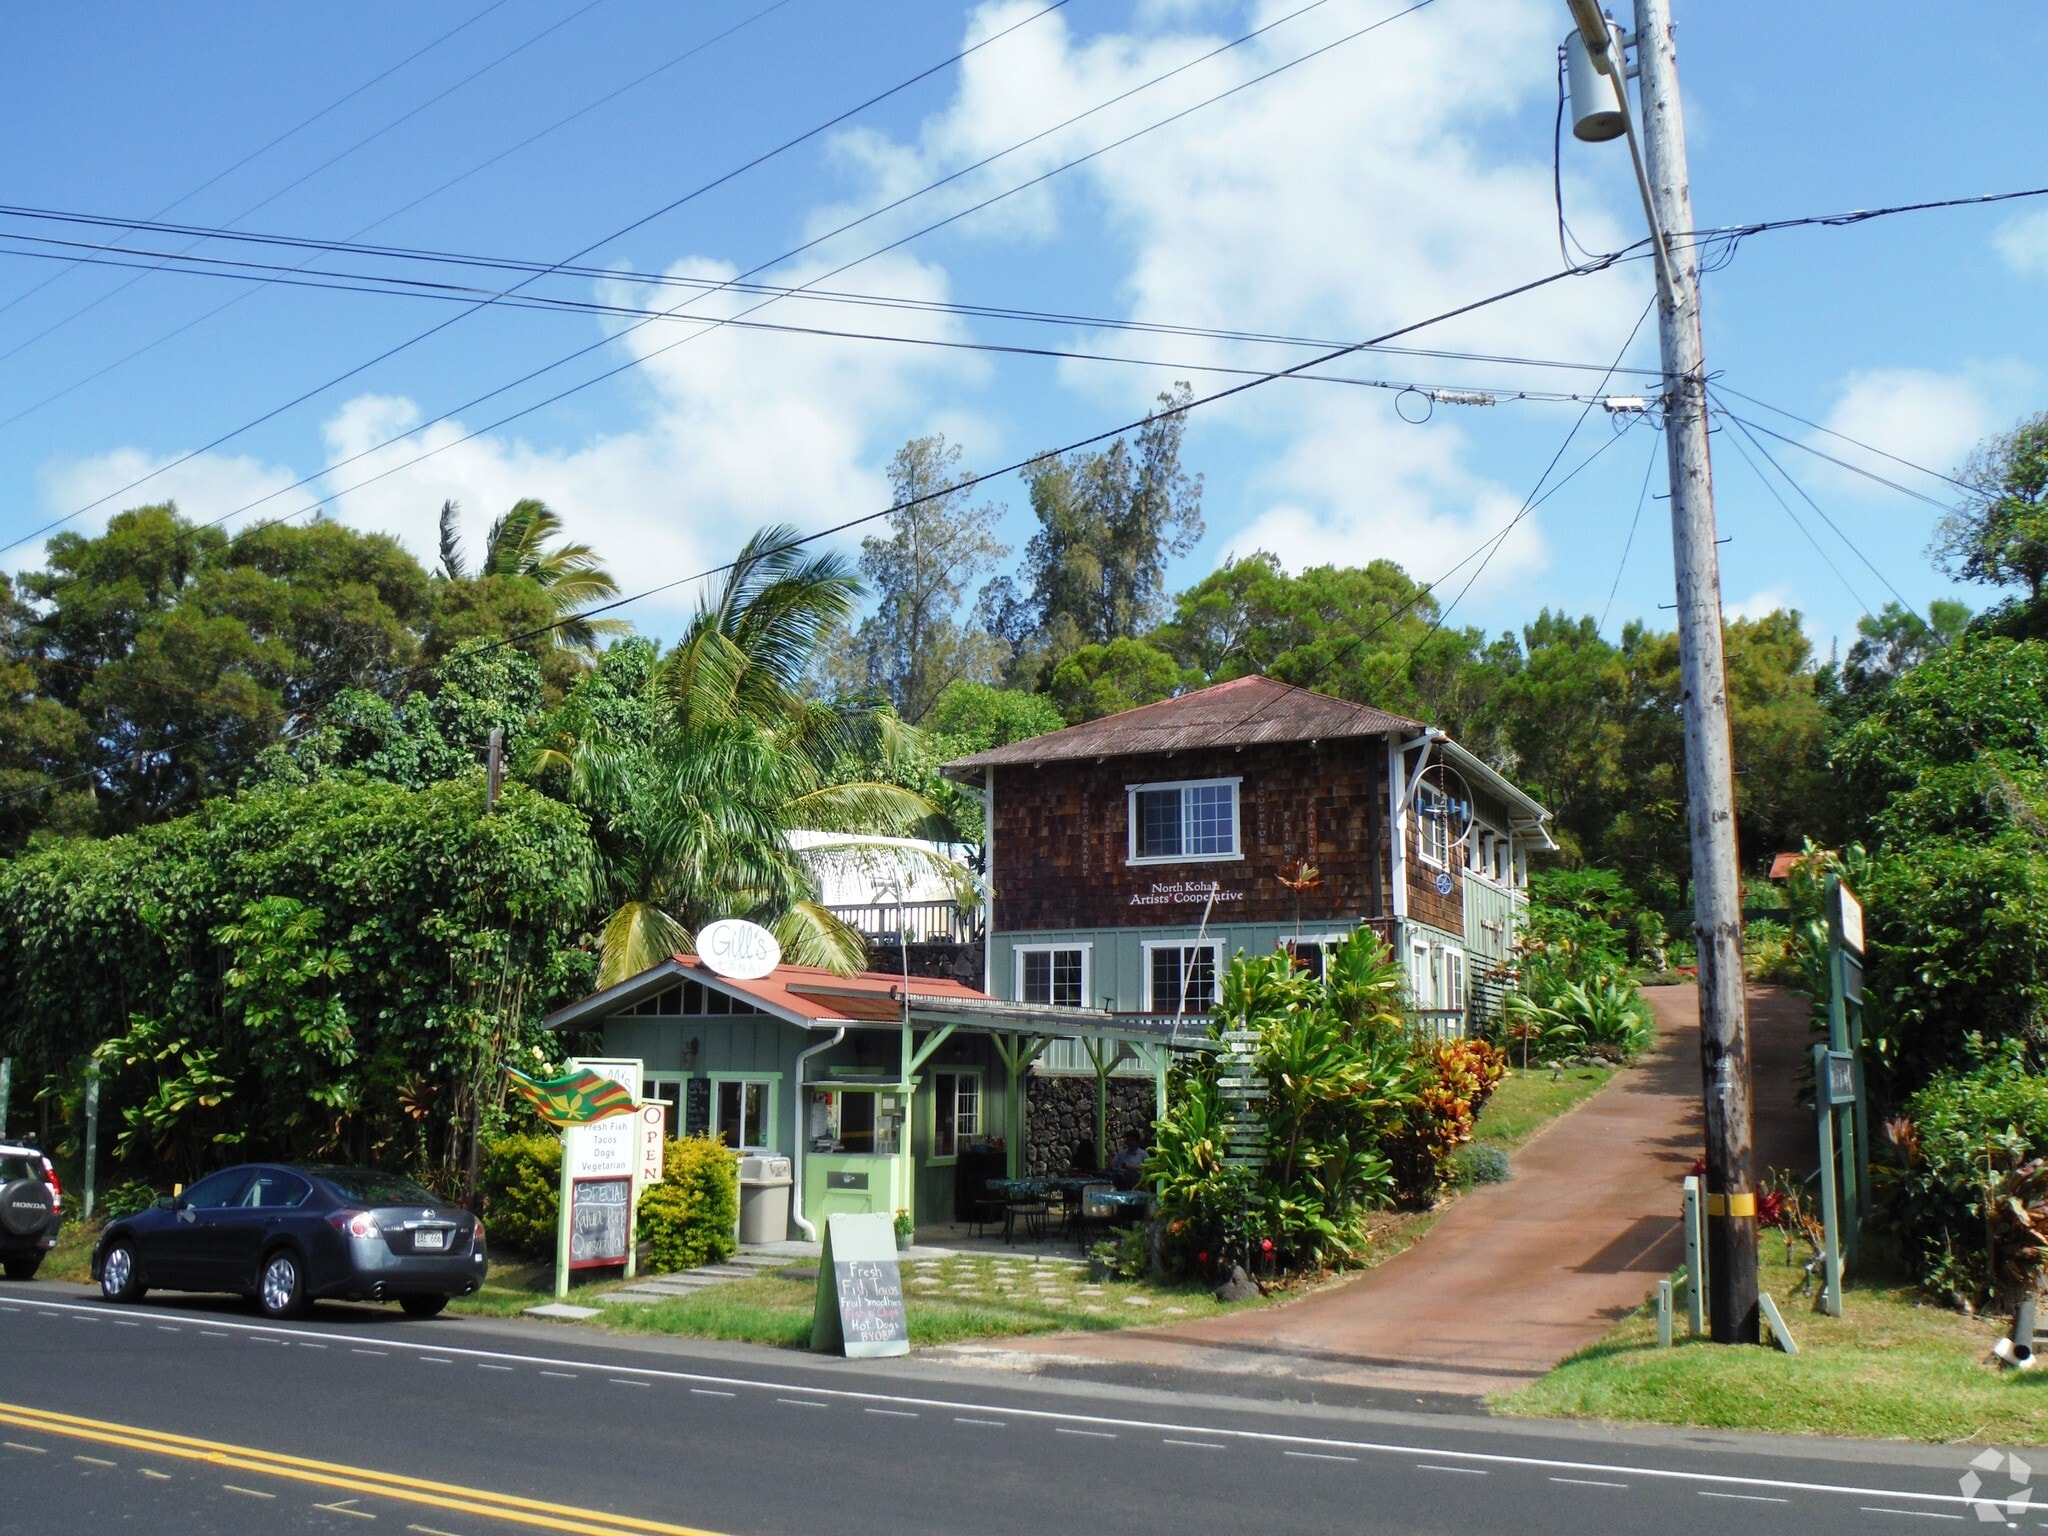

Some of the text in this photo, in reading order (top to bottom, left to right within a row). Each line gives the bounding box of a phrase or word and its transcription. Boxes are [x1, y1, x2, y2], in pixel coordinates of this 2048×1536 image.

[1307, 799, 1317, 862] PAINTING
[1152, 882, 1183, 893] North
[1130, 893, 1172, 905] Artists'
[712, 924, 767, 960] Gill's
[610, 1122, 627, 1131] Fish
[594, 1135, 617, 1144] Tacos
[643, 1107, 661, 1180] OPEN
[594, 1148, 615, 1159] Dogs
[582, 1161, 626, 1172] Vegetarian
[577, 1182, 627, 1202] SPECIAL
[12, 1201, 47, 1209] HONDA
[849, 1261, 883, 1278] Fresh
[842, 1277, 899, 1297] Fish Tacos
[852, 1317, 900, 1332] Hot Dogs
